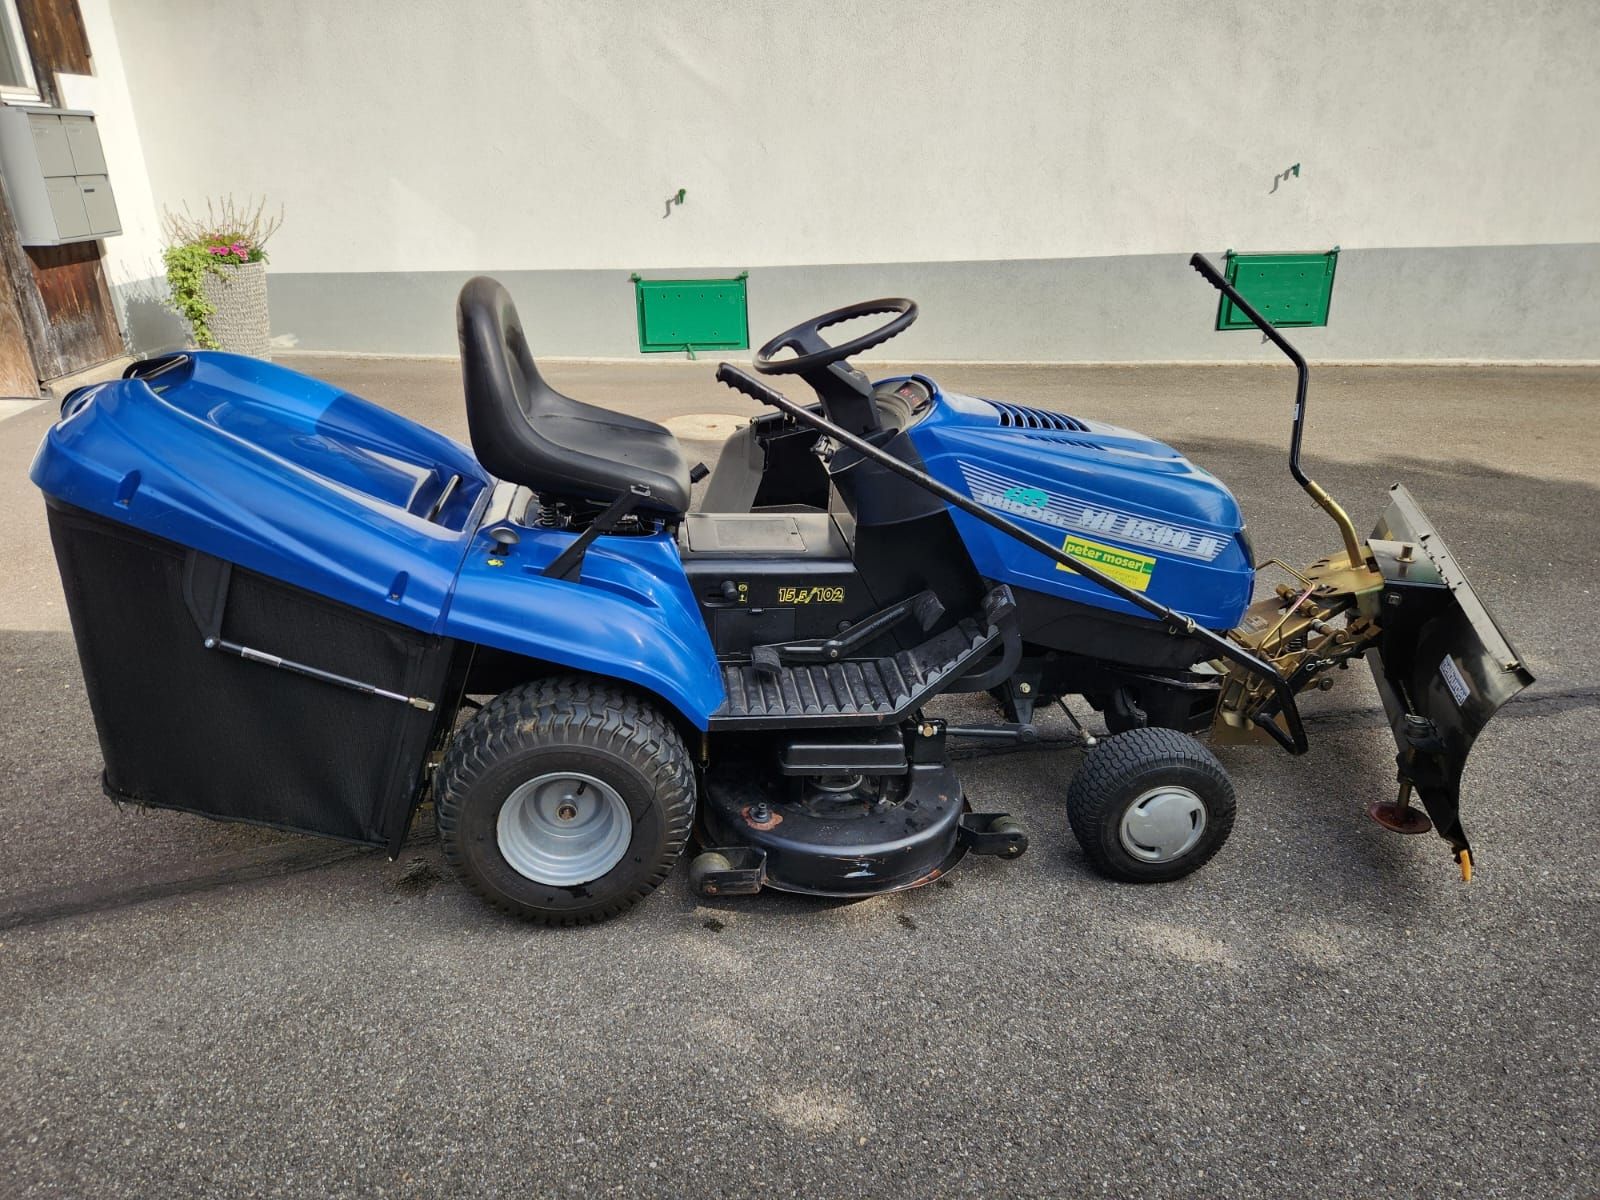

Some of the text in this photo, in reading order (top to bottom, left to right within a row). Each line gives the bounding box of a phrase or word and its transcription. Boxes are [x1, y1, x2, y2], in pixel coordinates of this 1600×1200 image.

[982, 493, 1065, 526] MIDORI
[1121, 517, 1192, 549] 1500
[1066, 543, 1141, 570] peter moser
